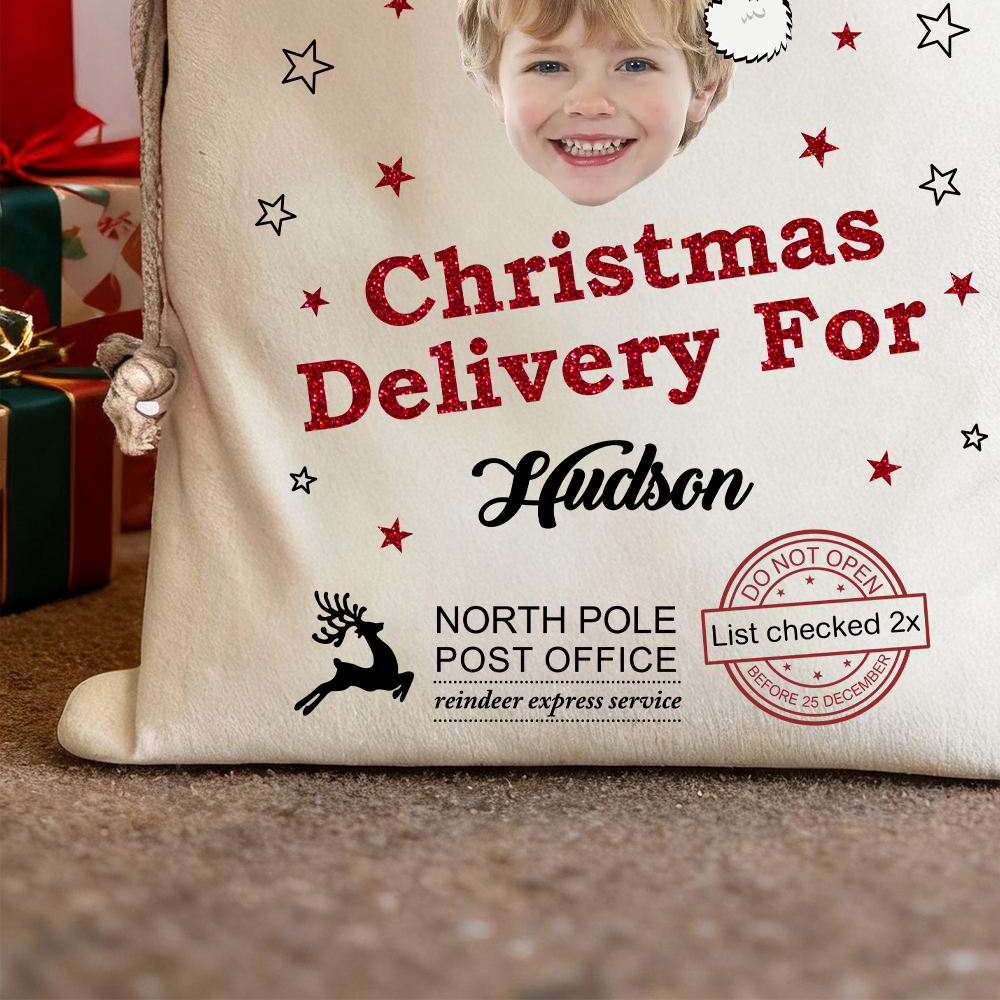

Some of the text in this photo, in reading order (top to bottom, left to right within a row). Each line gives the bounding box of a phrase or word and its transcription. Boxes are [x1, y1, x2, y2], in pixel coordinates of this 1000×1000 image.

[365, 209, 885, 327] Christmas
[297, 296, 927, 432] Delivery For
[471, 439, 755, 530] Hudson
[741, 547, 884, 601] DO NOT OPEN
[436, 605, 677, 634] NORTH POLE
[711, 610, 921, 647] List checked 2x
[436, 646, 677, 673] POST OFFICE
[747, 653, 892, 708] BEFORE 25 DECEMBER
[434, 689, 682, 718] reindeer express service
